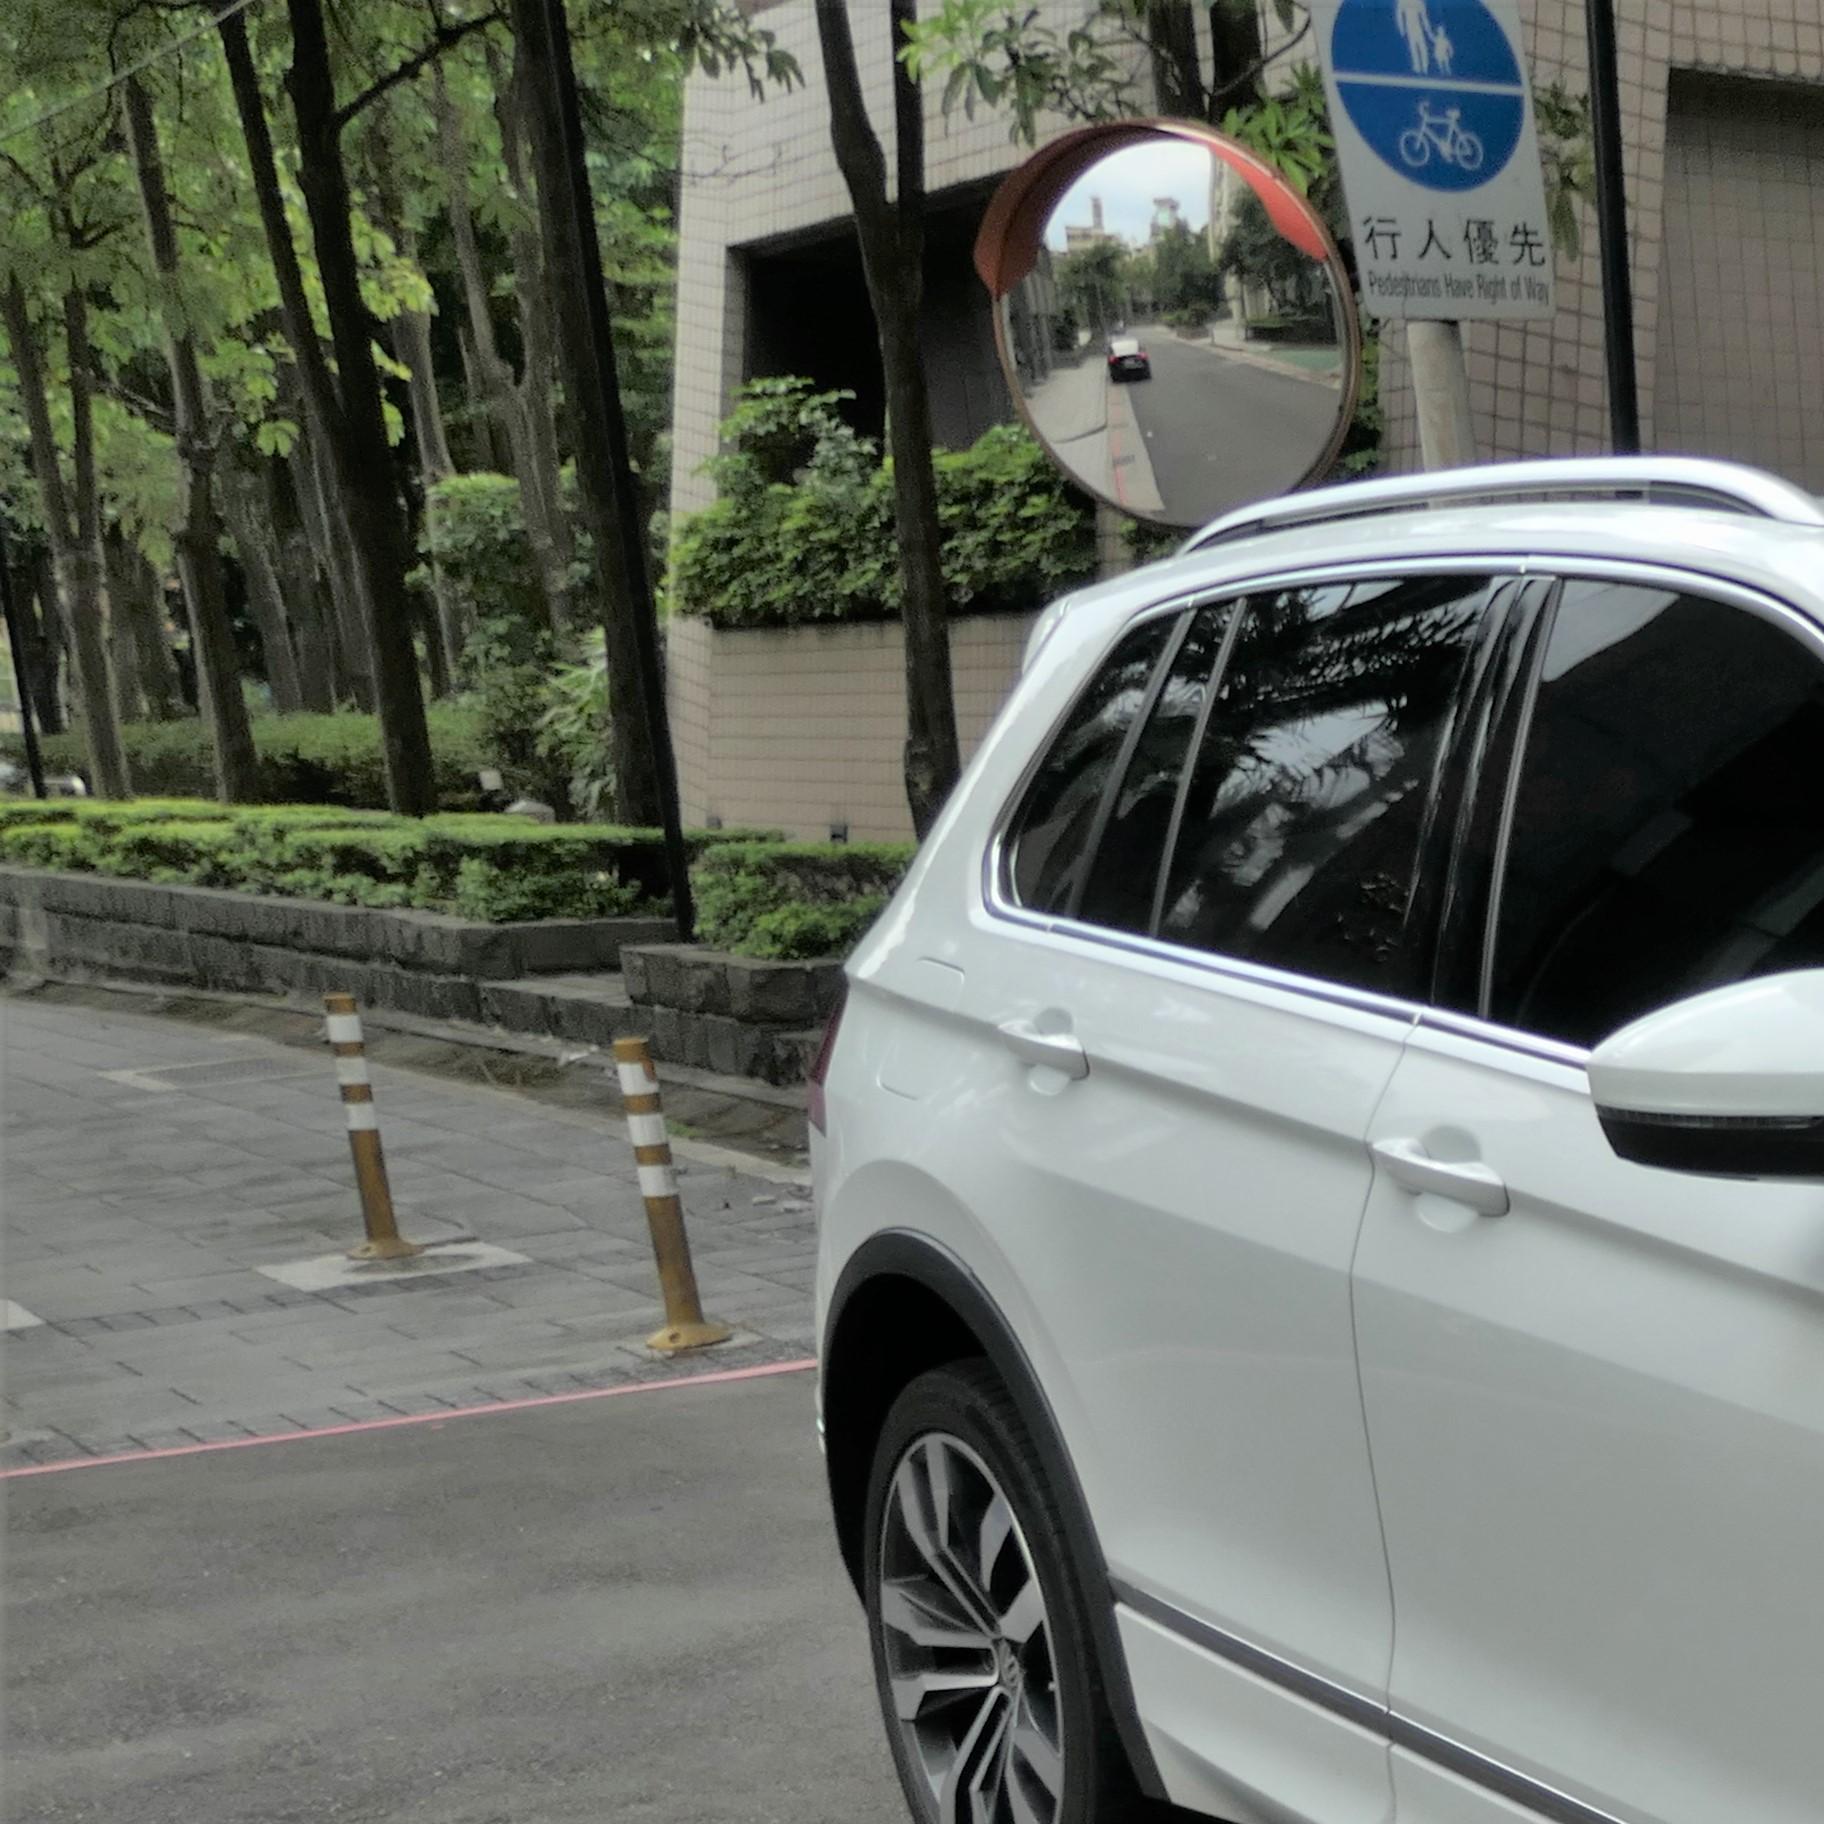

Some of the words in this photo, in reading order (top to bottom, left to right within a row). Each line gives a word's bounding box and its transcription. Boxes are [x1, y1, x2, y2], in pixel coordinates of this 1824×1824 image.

[1363, 216, 1546, 266] 行人優先
[1444, 273, 1473, 299] Have
[1476, 273, 1507, 304] Right
[1510, 273, 1521, 300] of
[1524, 275, 1549, 305] Way
